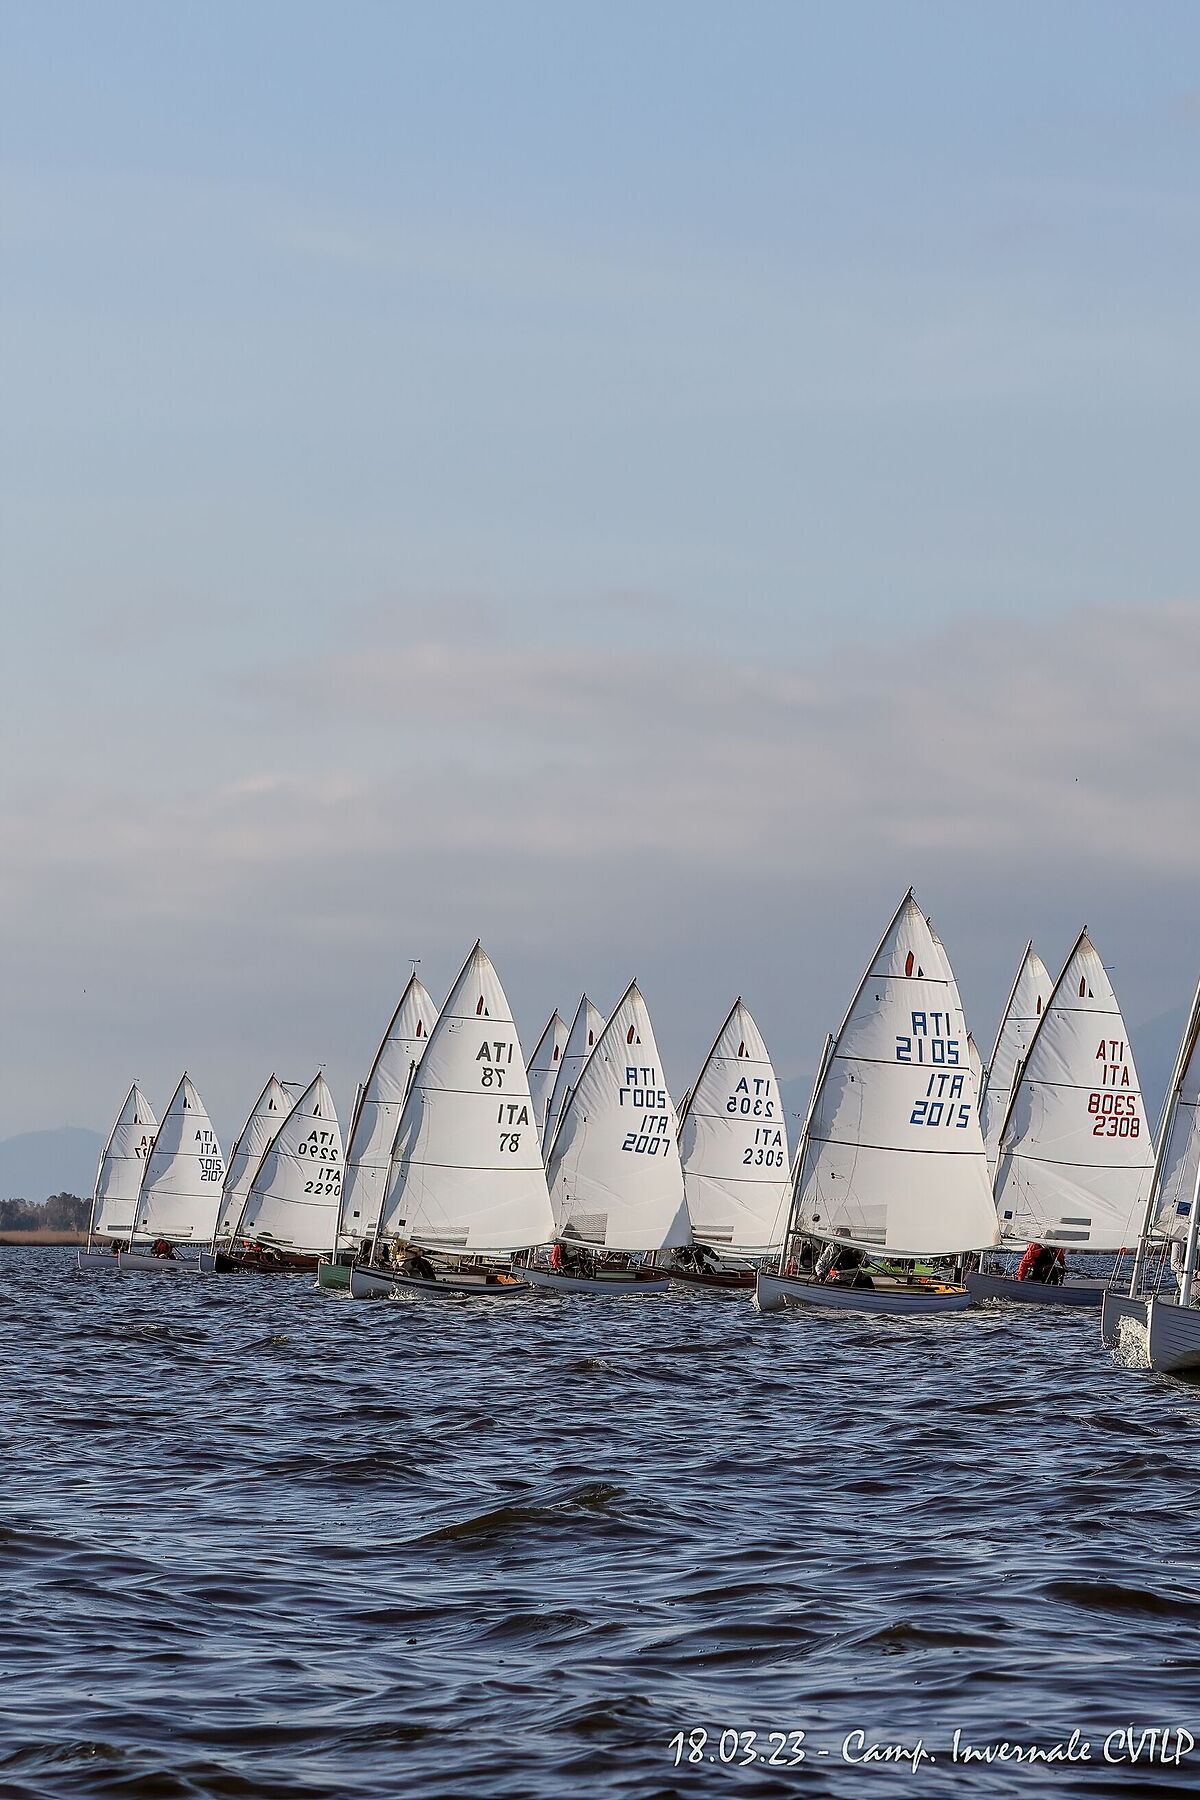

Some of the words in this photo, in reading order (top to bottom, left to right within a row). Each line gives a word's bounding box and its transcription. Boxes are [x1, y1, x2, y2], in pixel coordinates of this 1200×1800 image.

[1102, 1065, 1130, 1086] ITA
[927, 1073, 964, 1098] ITA
[497, 1104, 529, 1125] ITA
[910, 1100, 971, 1128] 2015
[640, 1115, 669, 1134] ITA
[1093, 1115, 1140, 1138] 2308
[499, 1133, 521, 1152] 78
[622, 1133, 671, 1157] 2007
[754, 1128, 782, 1147] ITA
[201, 1144, 217, 1154] ITA
[743, 1148, 784, 1167] 2305
[201, 1170, 224, 1181] 2107
[318, 1168, 341, 1181] ITA
[304, 1181, 341, 1196] 2290
